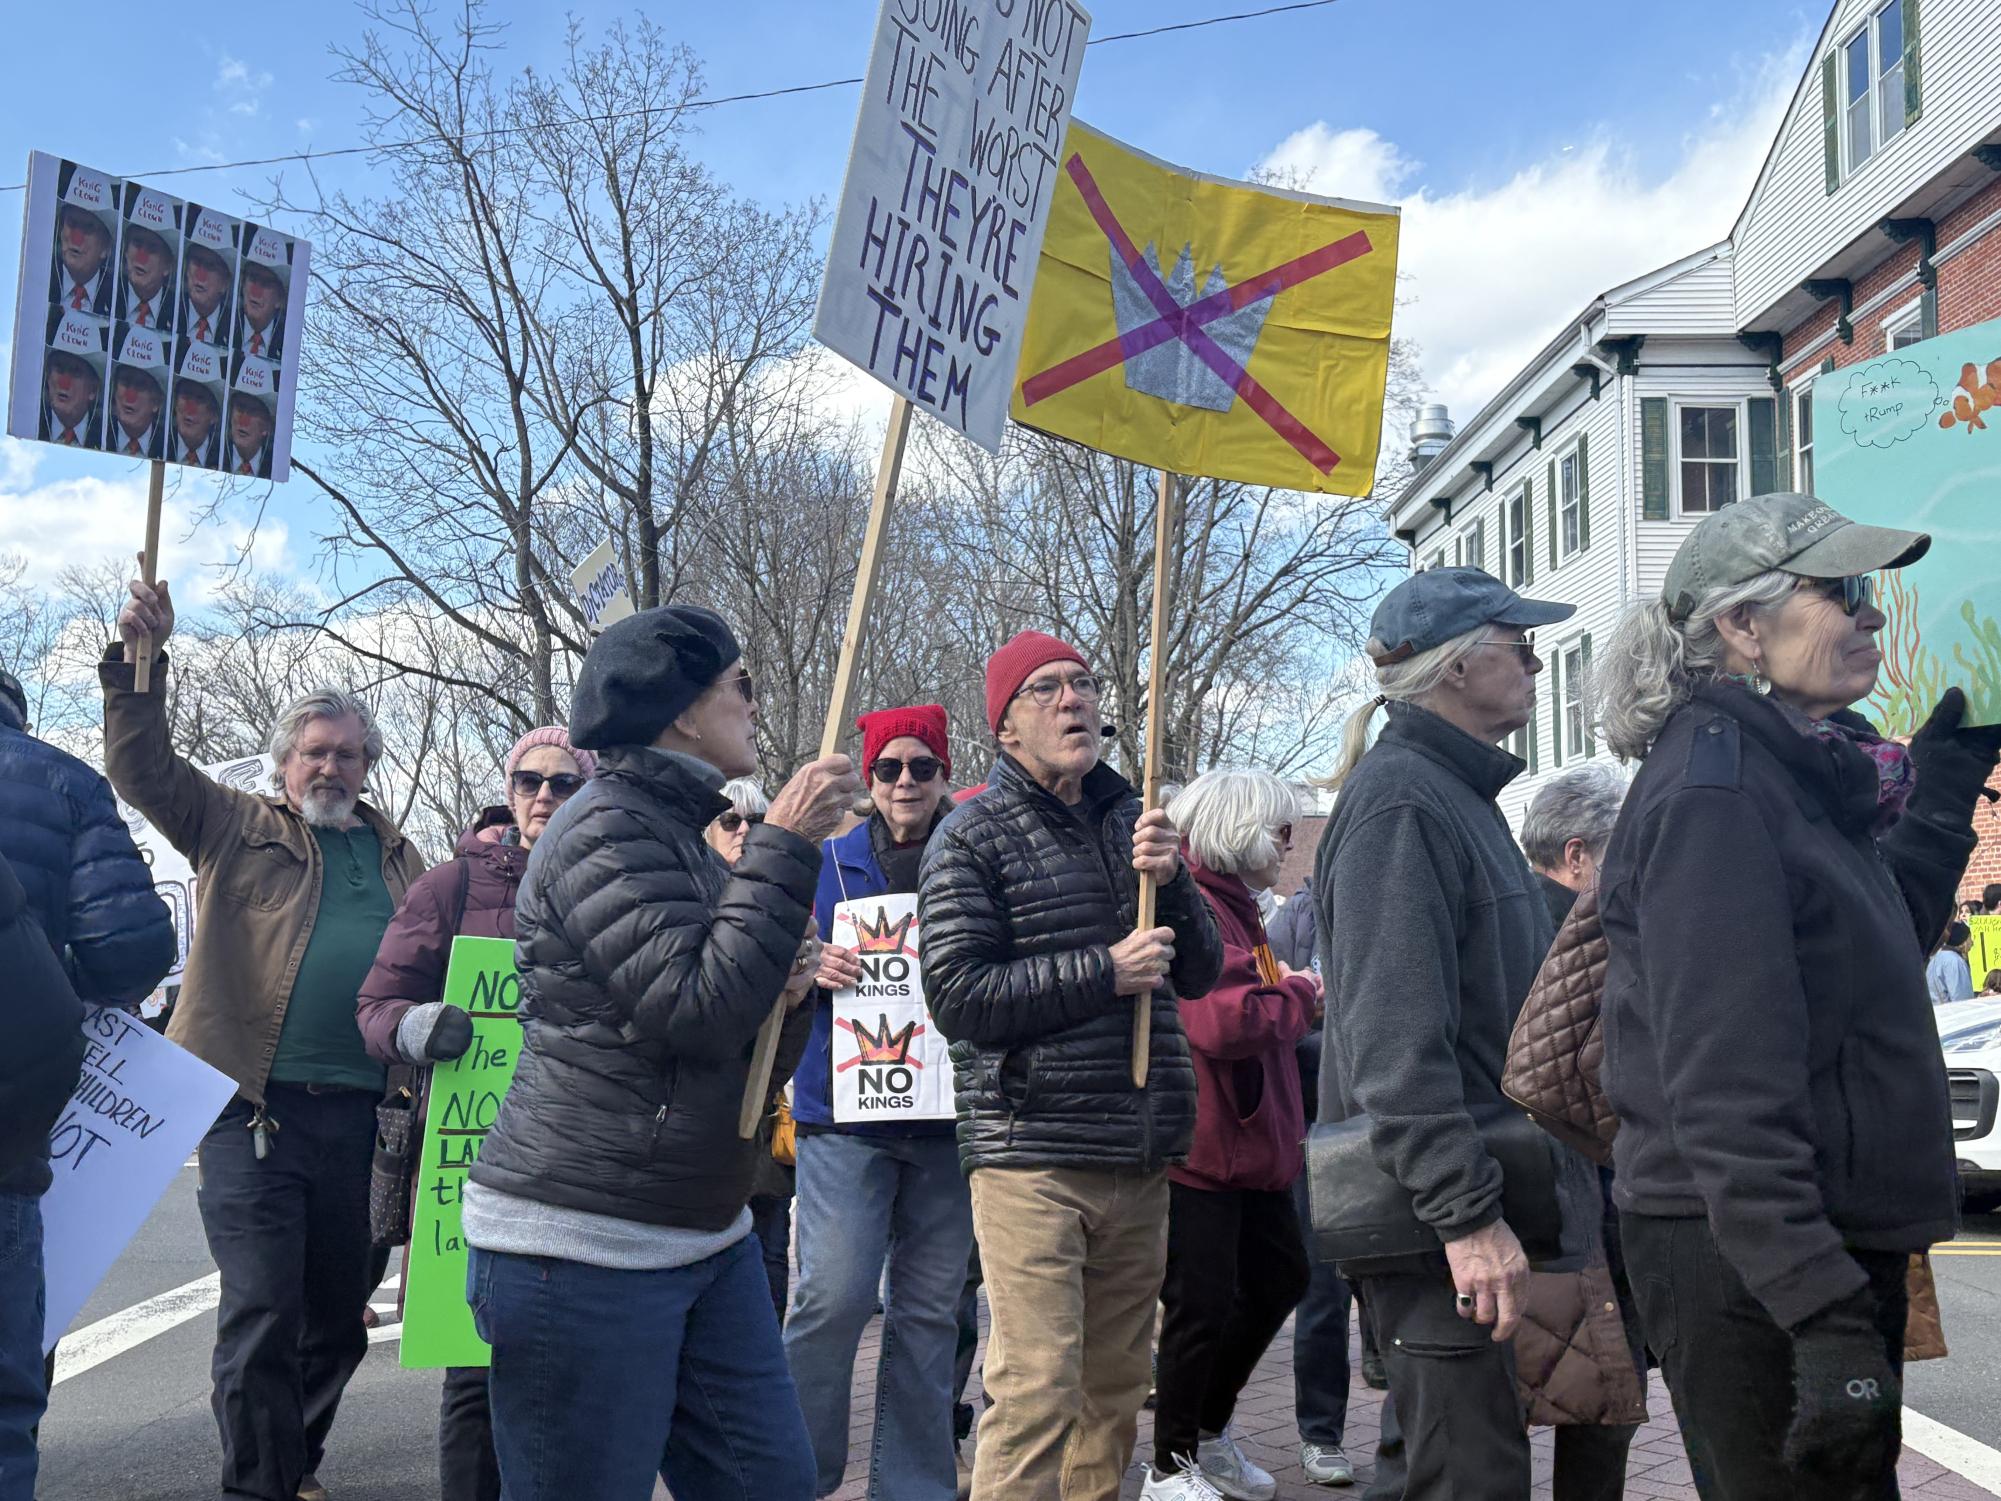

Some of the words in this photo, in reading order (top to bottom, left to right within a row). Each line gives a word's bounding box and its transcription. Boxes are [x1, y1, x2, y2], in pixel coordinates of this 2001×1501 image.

[1022, 0, 1087, 75] NOT
[887, 15, 947, 138] THE
[969, 98, 1058, 223] WORST
[987, 38, 1065, 156] AFTER
[859, 196, 1002, 357] HIRING
[867, 284, 973, 433] THEM
[855, 984, 910, 998] KINGS
[858, 956, 910, 983] NO
[858, 1066, 914, 1095] NO
[858, 1096, 914, 1110] KINGS
[1846, 1378, 1881, 1400] OR
